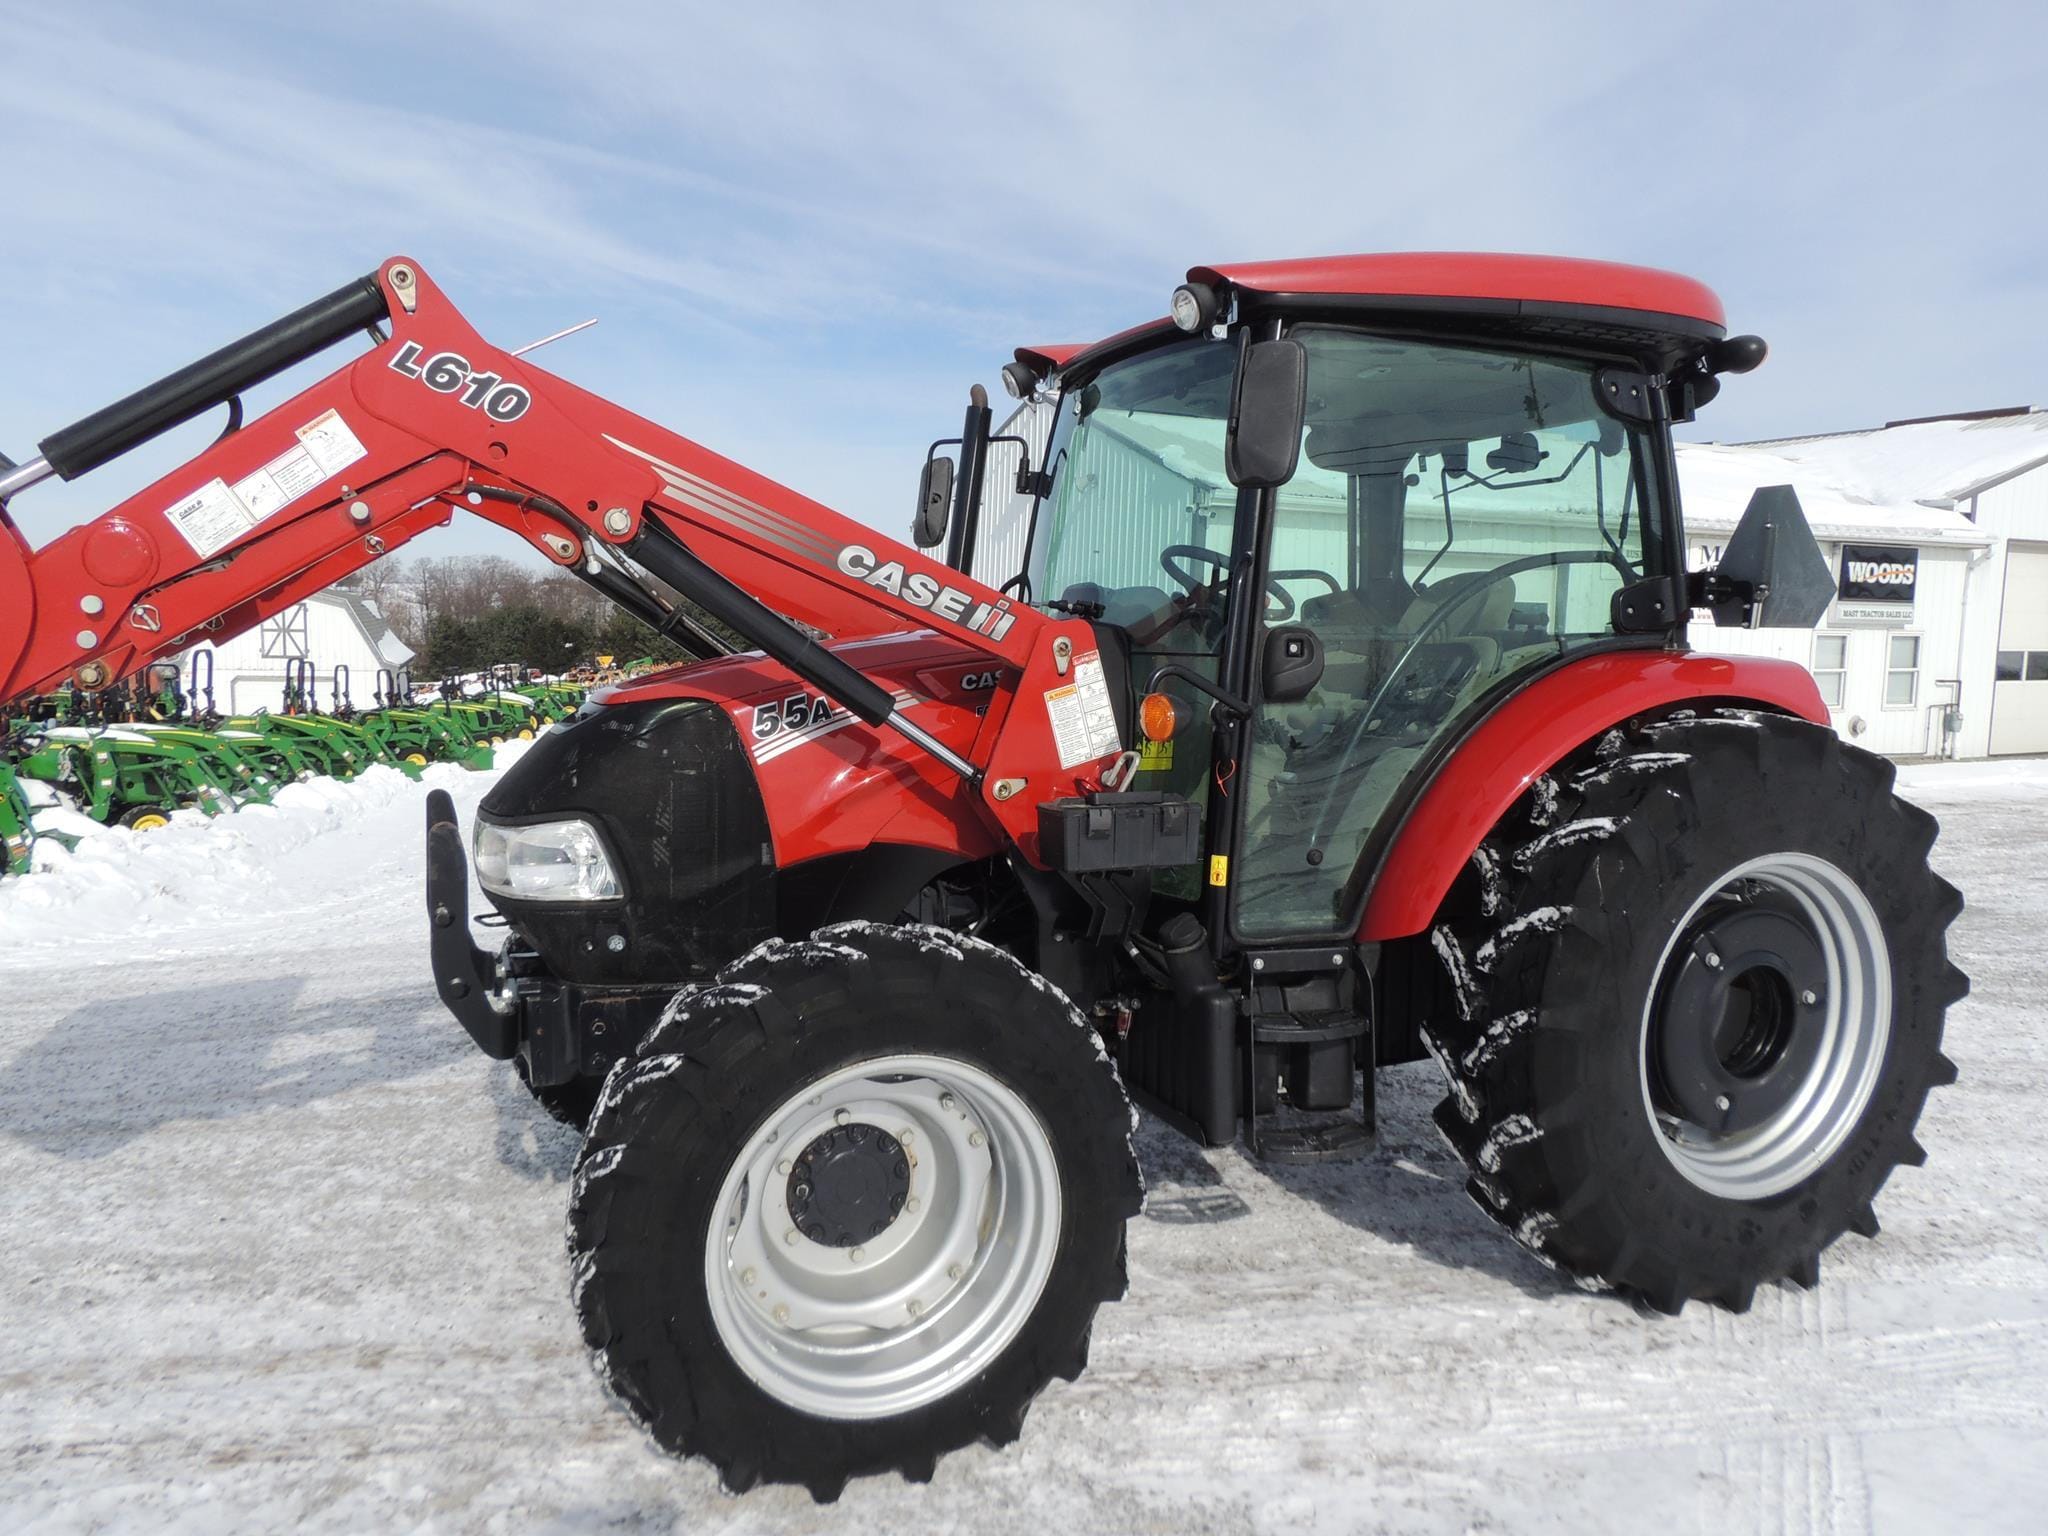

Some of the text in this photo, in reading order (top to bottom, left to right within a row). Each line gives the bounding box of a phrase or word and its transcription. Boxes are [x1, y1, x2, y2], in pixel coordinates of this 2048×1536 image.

[388, 340, 531, 422] L610
[837, 545, 973, 622] CASE
[1848, 561, 1915, 585] WOODS
[752, 693, 833, 740] 55A
